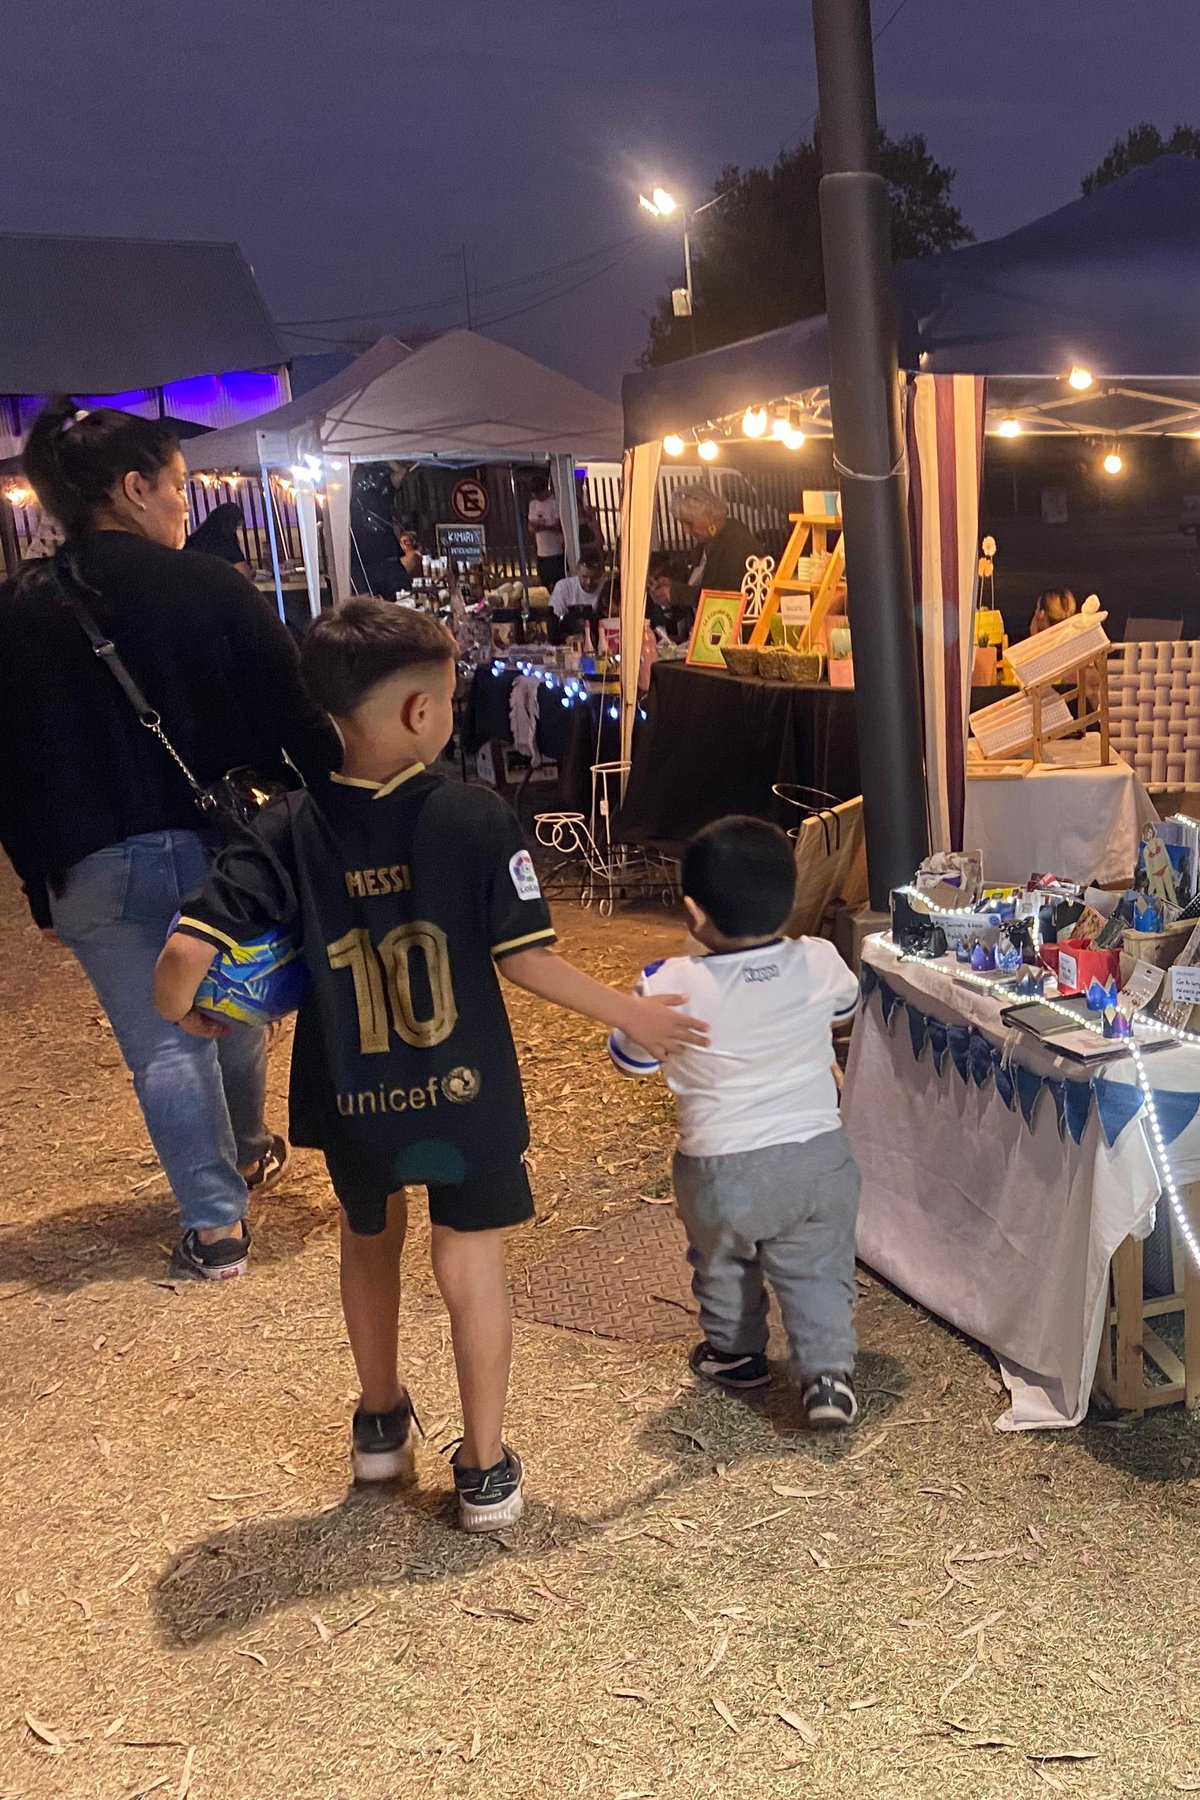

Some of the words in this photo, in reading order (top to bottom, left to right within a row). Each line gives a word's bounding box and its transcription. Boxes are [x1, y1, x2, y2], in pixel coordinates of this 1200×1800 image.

[345, 865, 412, 898] MESSI
[327, 920, 459, 1055] 10
[336, 1077, 438, 1116] unicef
